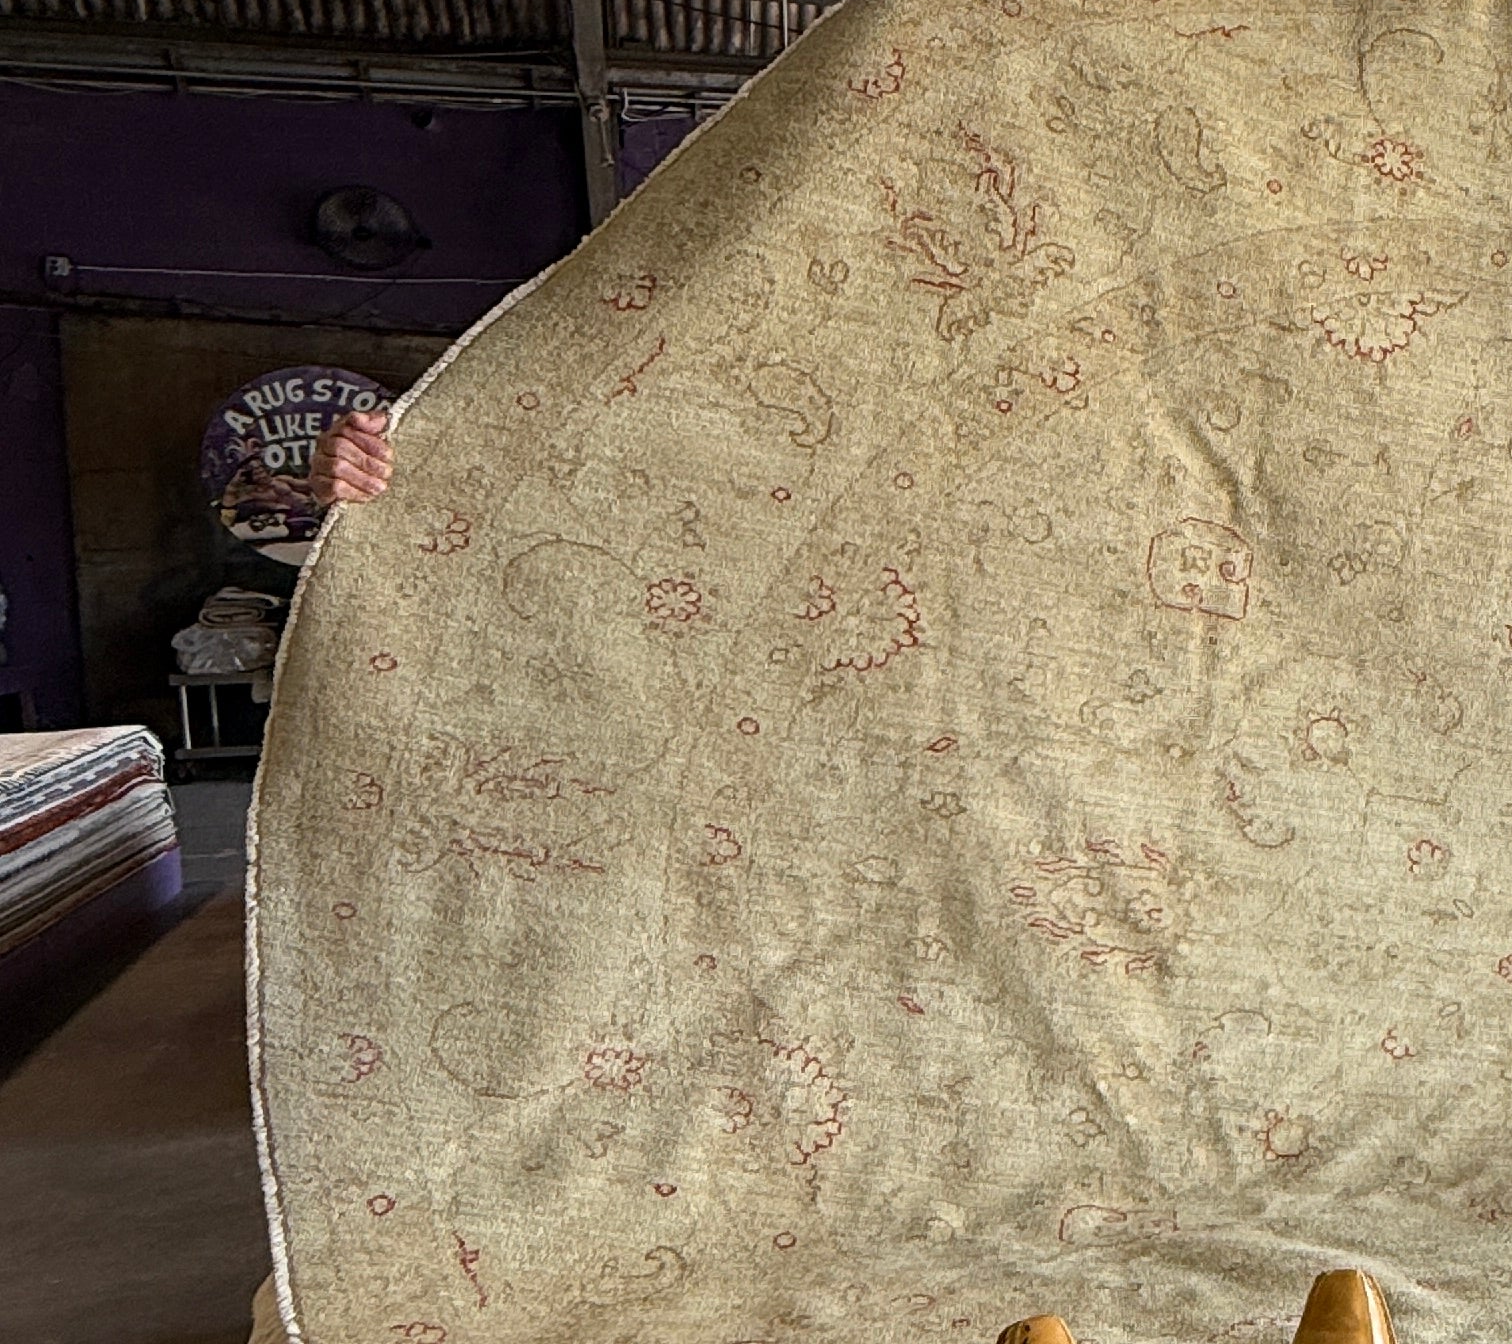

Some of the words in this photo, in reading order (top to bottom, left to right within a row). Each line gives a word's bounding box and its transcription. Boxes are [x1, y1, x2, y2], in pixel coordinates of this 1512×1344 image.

[224, 409, 253, 435] A
[243, 378, 304, 416] RUG
[258, 413, 322, 441] LIKE
